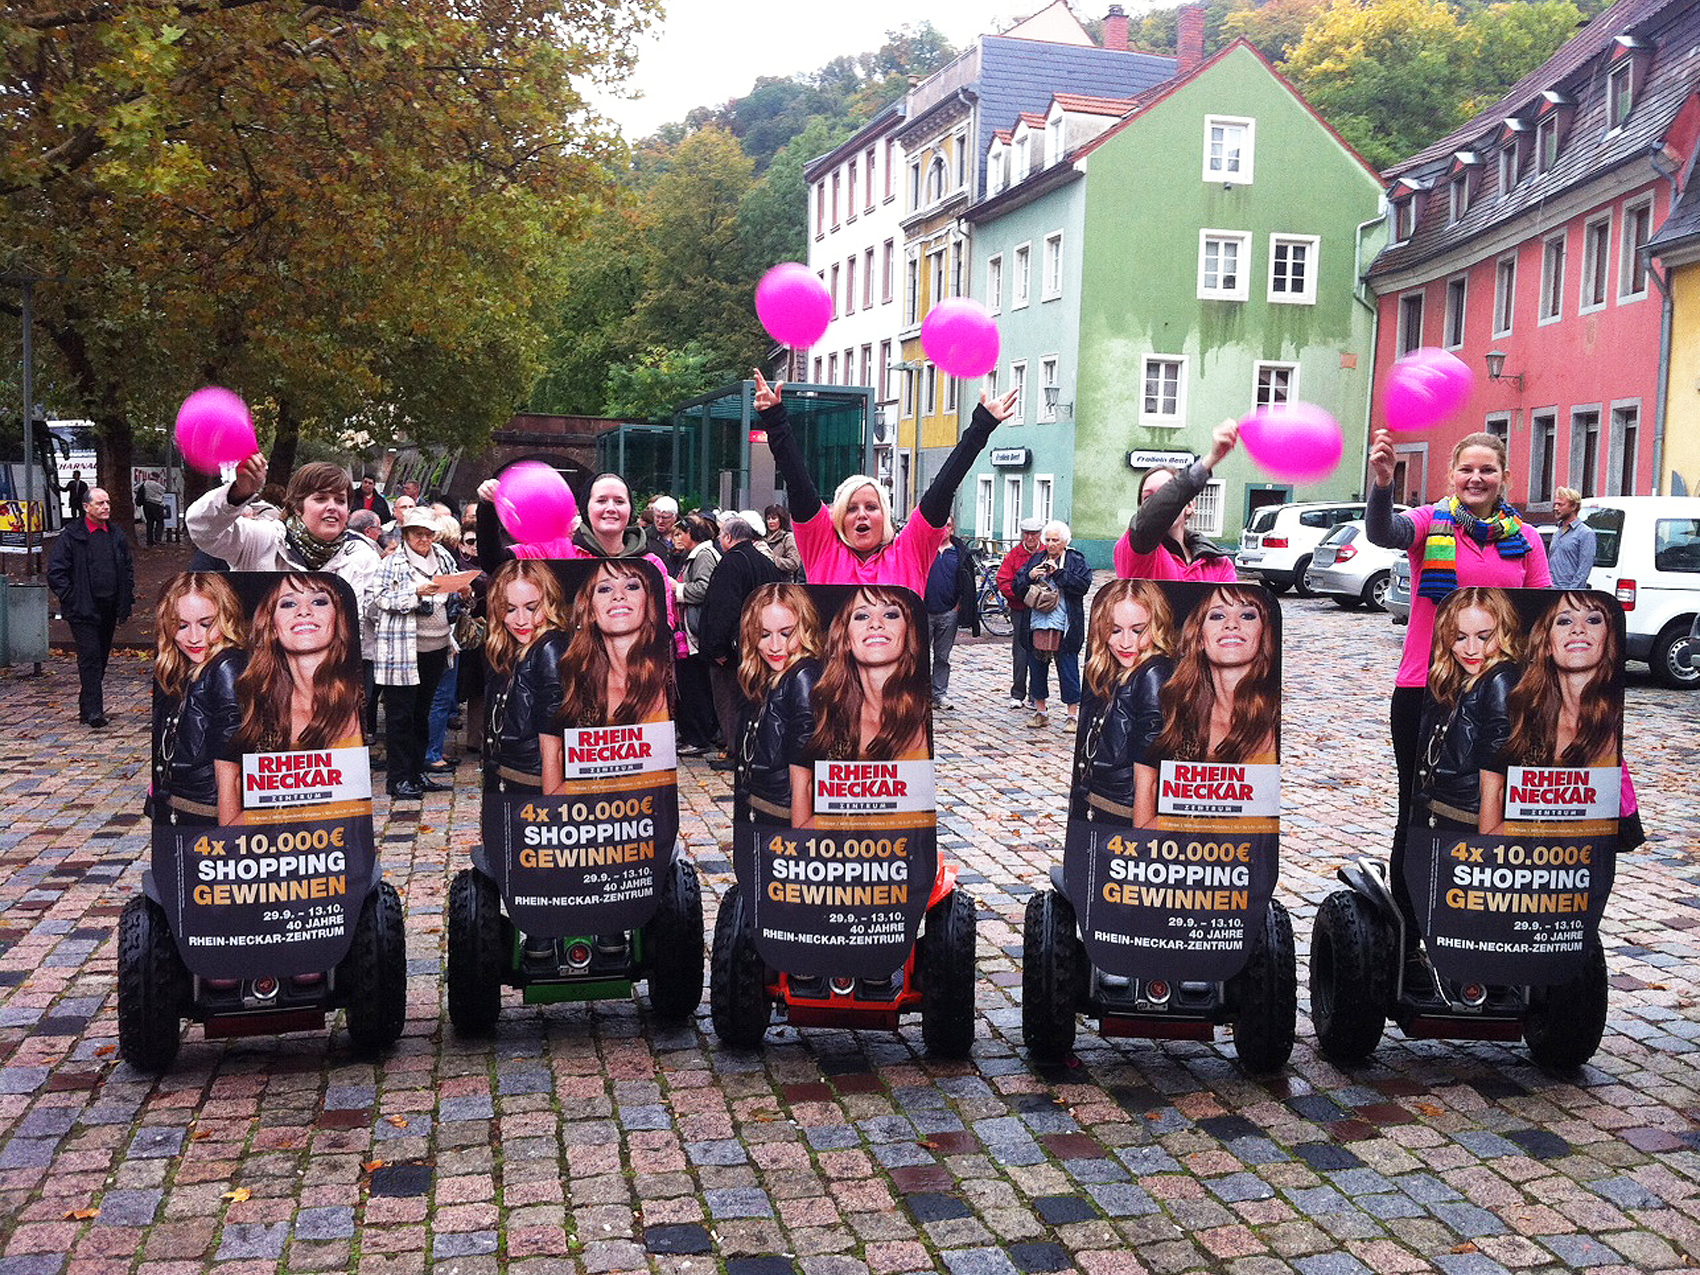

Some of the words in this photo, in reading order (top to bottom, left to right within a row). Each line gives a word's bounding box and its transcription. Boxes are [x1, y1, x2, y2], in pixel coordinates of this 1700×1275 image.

[578, 727, 643, 747] RHEIN
[569, 743, 652, 763] NECKAR
[258, 753, 332, 774] RHEIN
[590, 764, 634, 773] ZENTRUM
[829, 764, 898, 780] RHEIN
[247, 768, 343, 791] NECKAR
[1174, 764, 1245, 783] RHEIN
[1521, 770, 1590, 787] RHEIN
[271, 792, 322, 802] ZENTRUM
[818, 780, 908, 797] NECKAR
[1162, 780, 1254, 801] NECKAR
[1509, 786, 1597, 805] NECKAR
[520, 803, 550, 822] 4x
[557, 796, 653, 821] 10.000€
[1184, 804, 1232, 812] ZENTRUM
[524, 818, 654, 845] SHOPPING
[193, 836, 225, 856] 4x
[235, 828, 345, 854] 10.000€
[769, 835, 797, 857] 4x
[805, 838, 908, 858] 10.000€
[1107, 834, 1138, 857] 4x
[1147, 839, 1251, 863] 10.000€
[519, 840, 655, 868] GEWINNEN
[1451, 842, 1484, 863] 4x
[1493, 845, 1593, 866] 10.000€
[198, 851, 346, 881] SHOPPING
[583, 873, 611, 883] 29.9.
[622, 868, 653, 879] 13.10.
[772, 858, 908, 882] SHOPPING
[1109, 858, 1249, 887] SHOPPING
[603, 882, 617, 892] 40
[619, 876, 653, 890] JAHRE
[1453, 865, 1590, 890] SHOPPING
[193, 875, 346, 905] GEWINNEN
[515, 887, 653, 906] RHEIN-NECKAR-ZENTRUM
[767, 882, 908, 906] GEWINNEN
[1103, 883, 1248, 910] GEWINNEN
[1445, 889, 1589, 913] GEWINNEN
[263, 911, 295, 921] 29.9.
[308, 905, 344, 916] 13.10.
[286, 920, 302, 930] 40
[305, 915, 344, 928] JAHRE
[829, 913, 858, 923] 29.9.
[871, 912, 905, 922] 13.10.
[1168, 917, 1198, 927] 29.9.
[1210, 918, 1244, 927] 13.10.
[850, 924, 864, 933] 40
[867, 922, 905, 933] JAHRE
[1189, 929, 1204, 939] 40
[1206, 929, 1244, 939] JAHRE
[1513, 921, 1543, 931] 29.9.
[1554, 920, 1584, 930] 13.10.
[189, 926, 345, 946] RHEIN-NECKAR-ZENTRUM
[763, 928, 905, 945] RHEIN-NECKAR-ZENTRUM
[1094, 931, 1243, 950] RHEIN-NECKAR-ZENTRUM
[1436, 936, 1583, 953] RHEIN-NECKAR-ZENTRUM
[1533, 932, 1548, 942] 40
[1550, 931, 1583, 941] JAHRE
